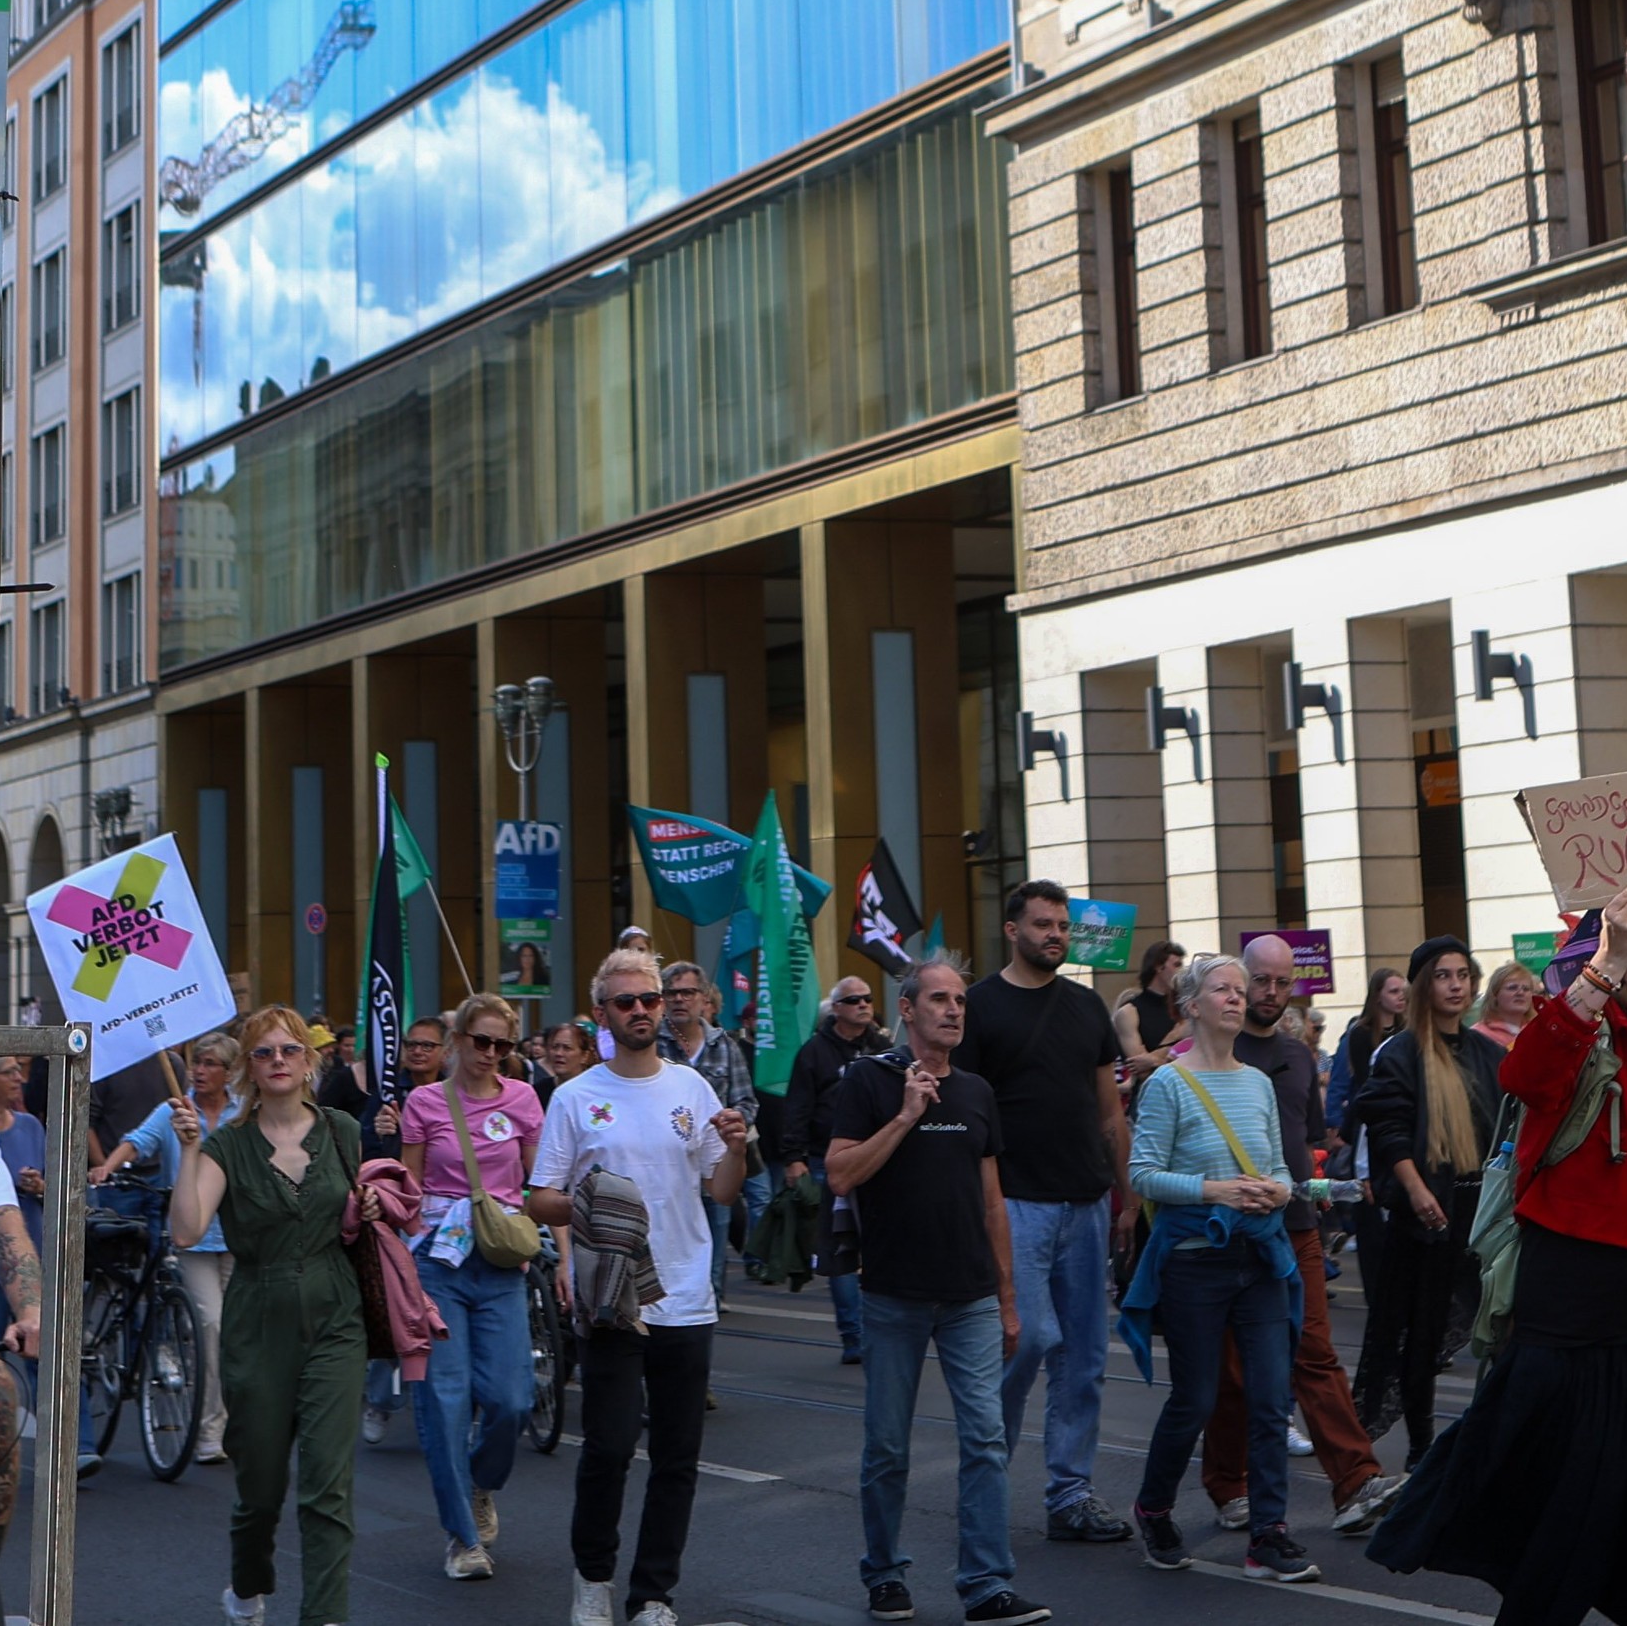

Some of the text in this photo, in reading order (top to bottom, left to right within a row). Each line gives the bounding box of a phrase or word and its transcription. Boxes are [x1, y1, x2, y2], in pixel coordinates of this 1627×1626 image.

[495, 823, 561, 855] AfD
[651, 845, 700, 862] STATT
[71, 900, 166, 954] VERBOT
[91, 893, 136, 926] AFD
[94, 925, 160, 968] JETZT
[99, 982, 200, 1034] AFD-VERBOT.JETZT
